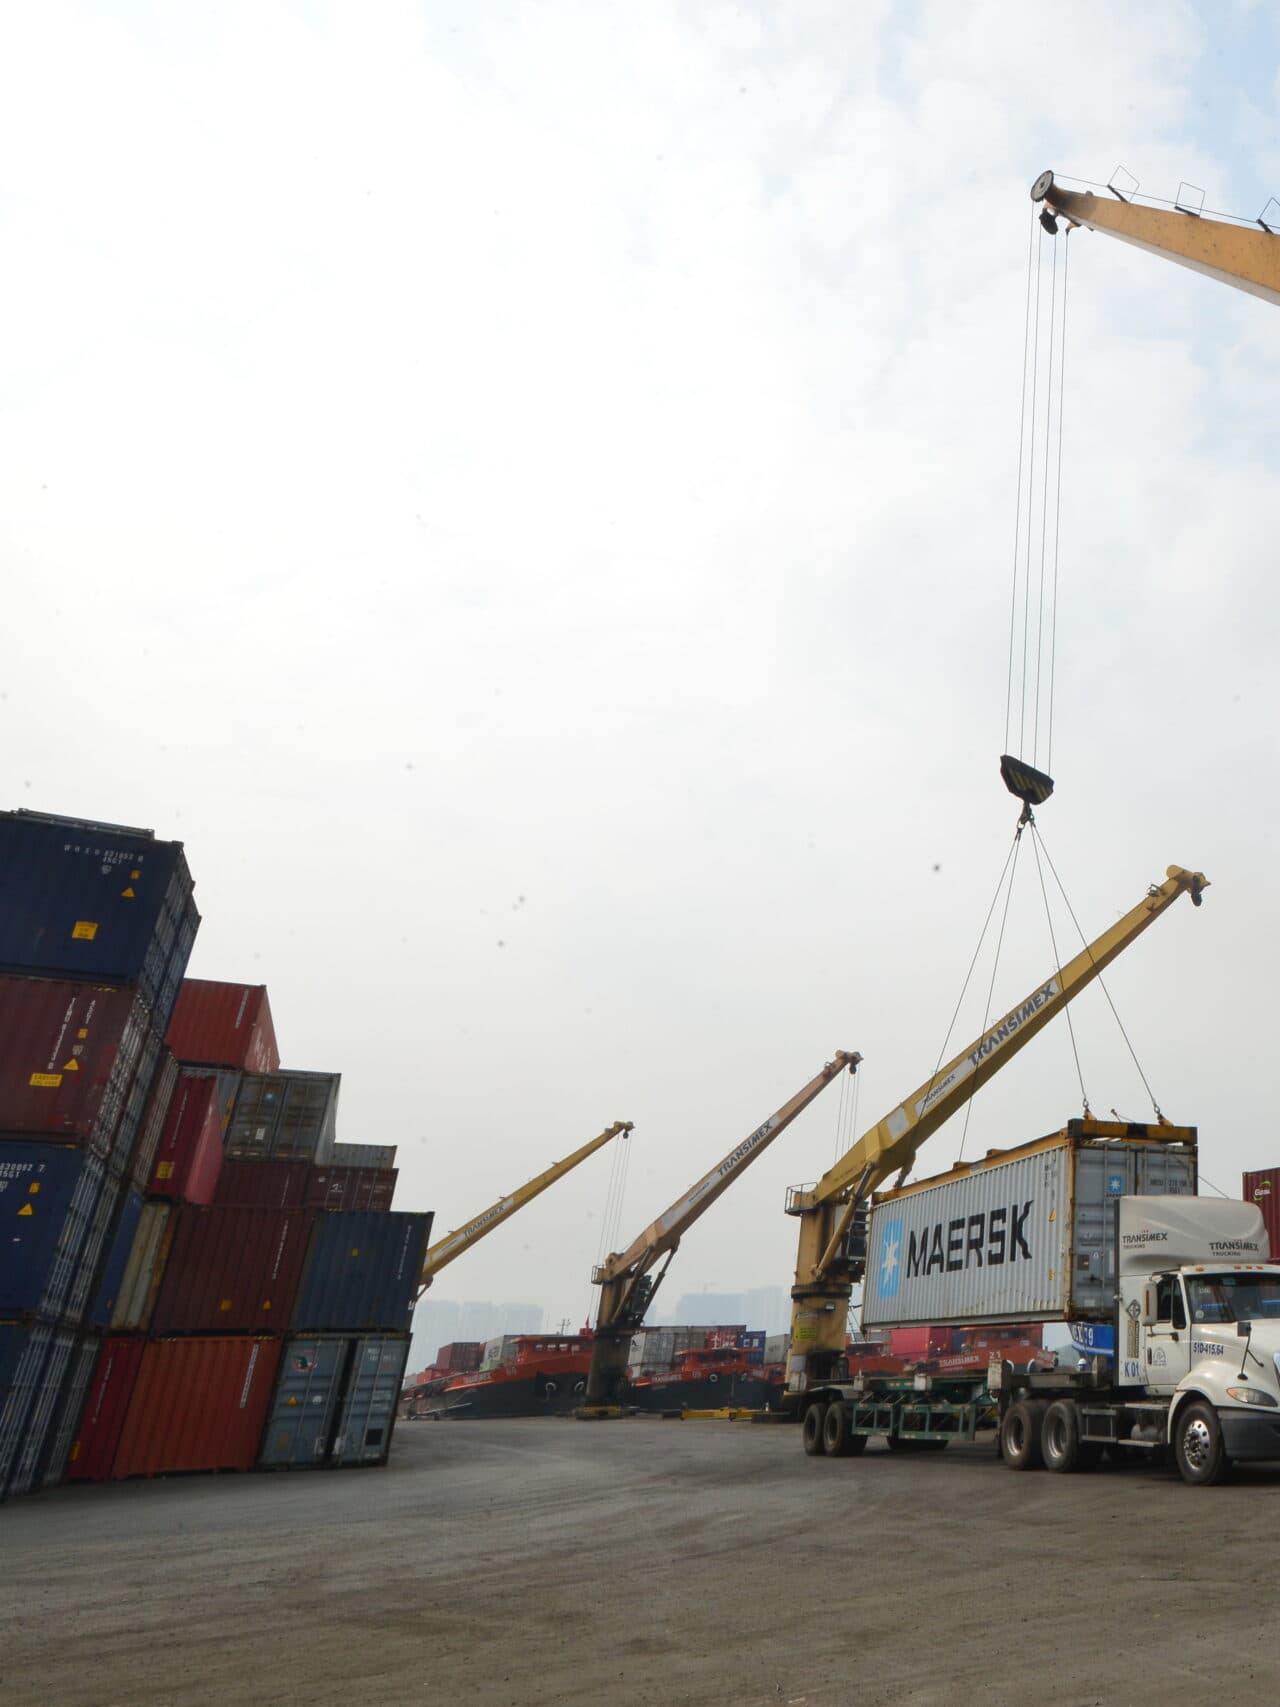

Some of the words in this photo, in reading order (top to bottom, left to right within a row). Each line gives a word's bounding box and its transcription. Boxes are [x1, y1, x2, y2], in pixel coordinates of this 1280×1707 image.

[967, 983, 1056, 1066] TRANSIMEX
[717, 1120, 773, 1176] TRANSIMEX
[906, 1199, 1035, 1279] MAERSK
[1122, 1231, 1168, 1244] TRANSIMEX
[1209, 1240, 1260, 1252] TRANSIMEX
